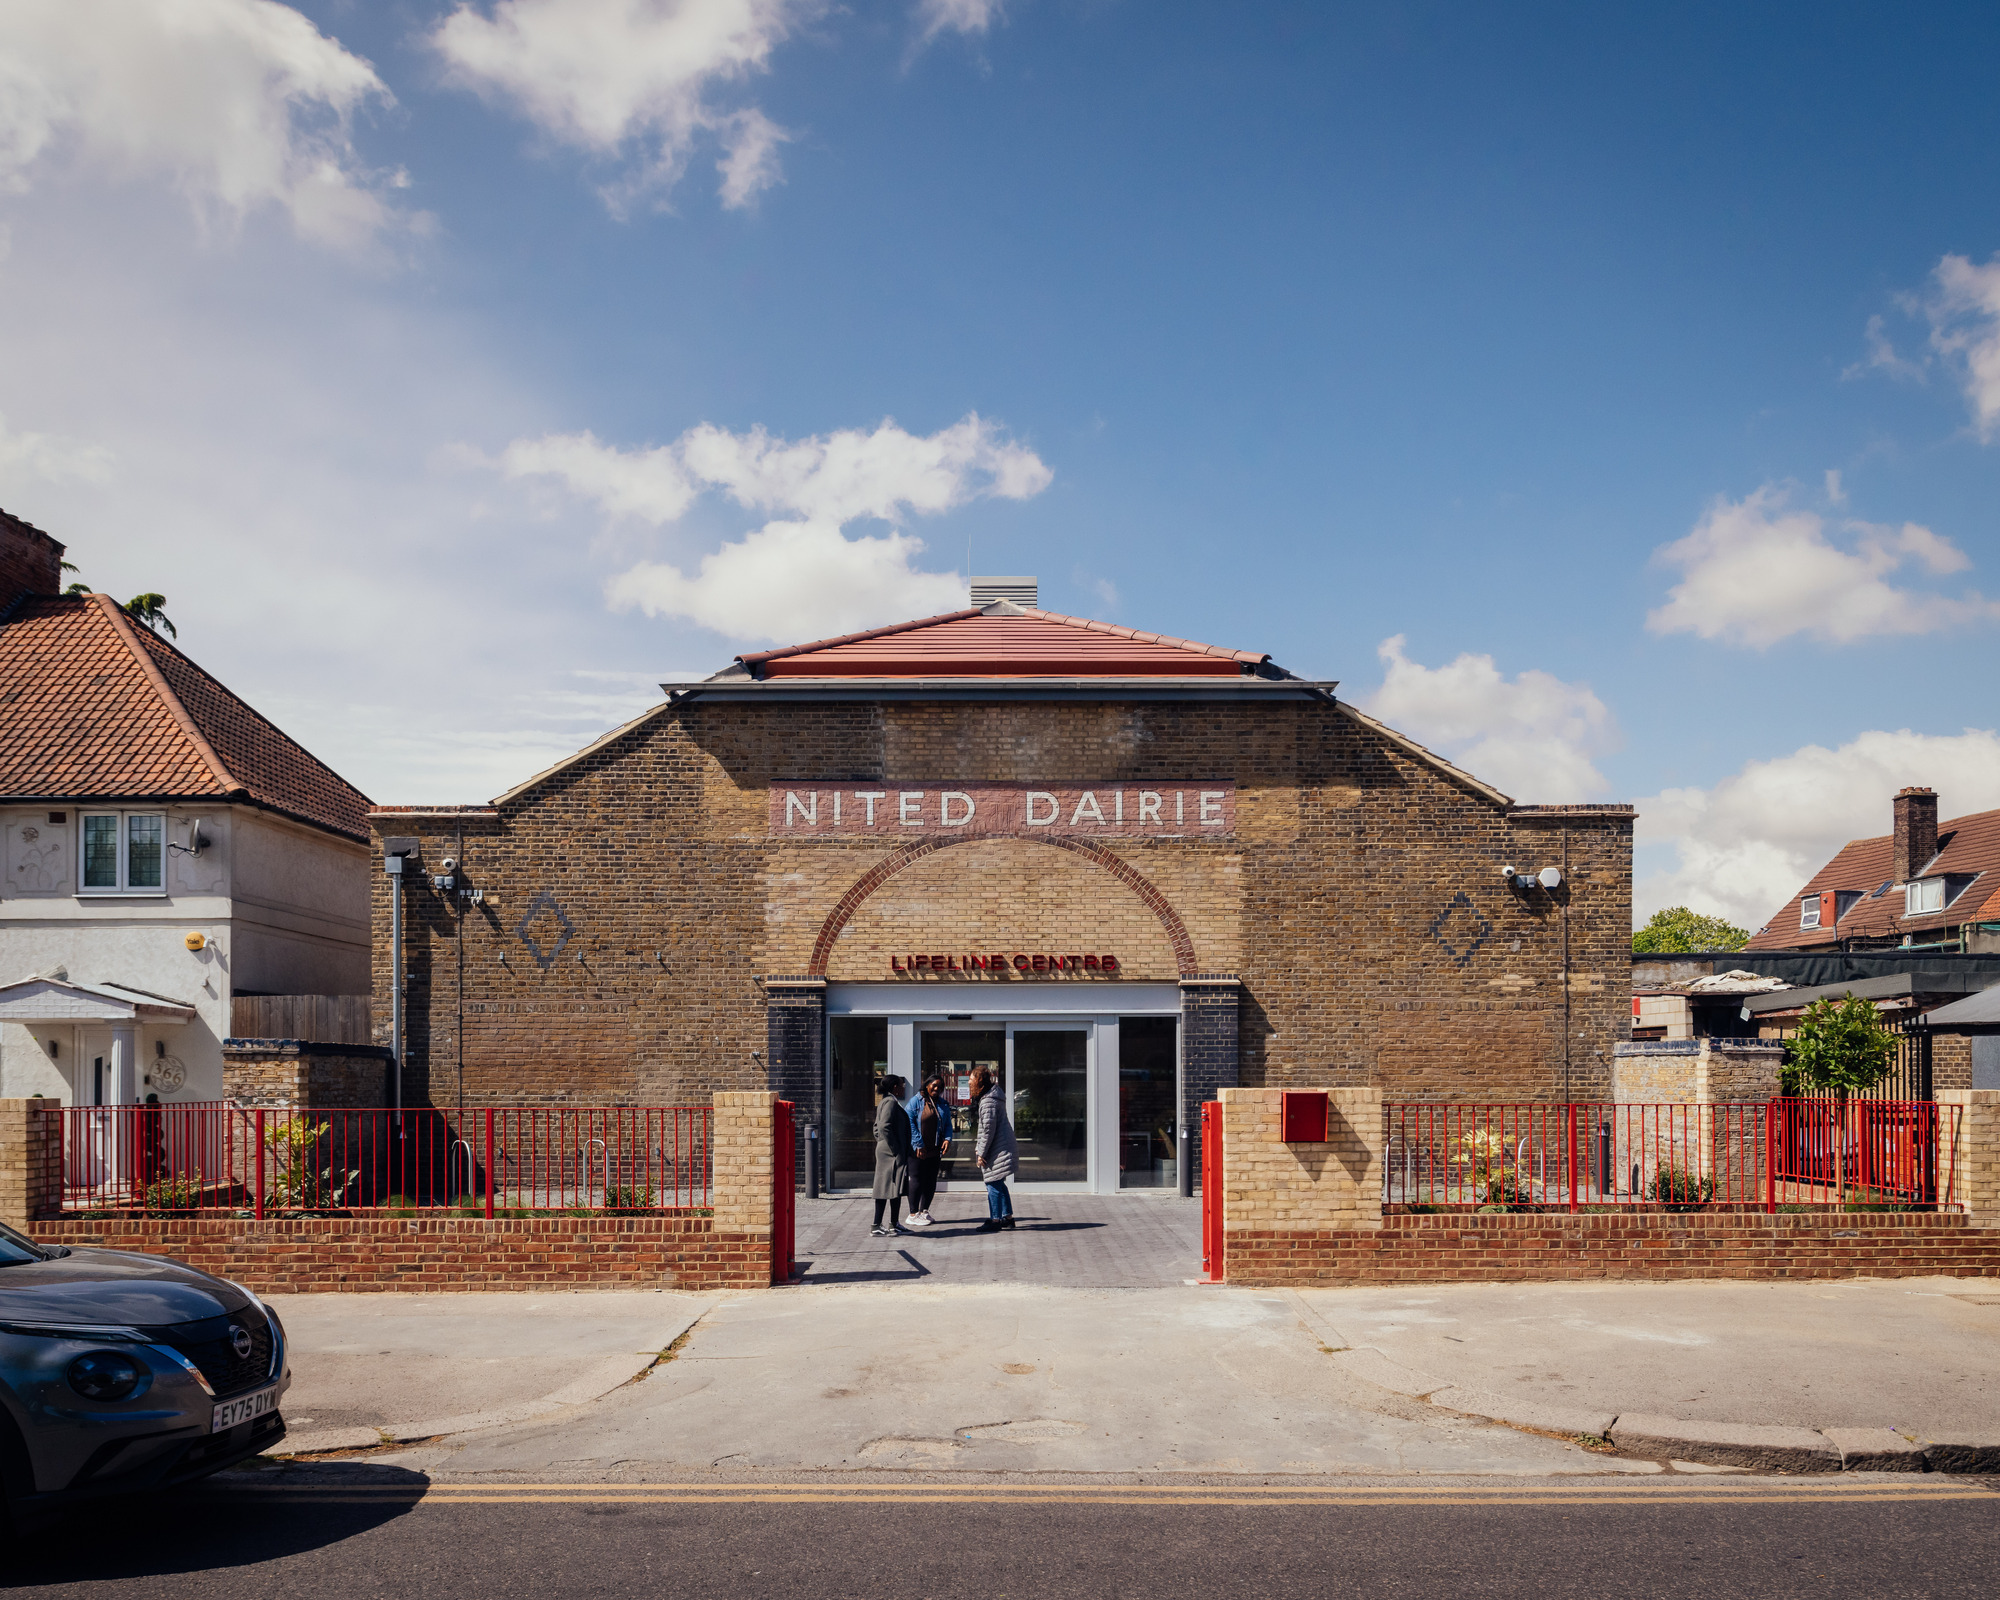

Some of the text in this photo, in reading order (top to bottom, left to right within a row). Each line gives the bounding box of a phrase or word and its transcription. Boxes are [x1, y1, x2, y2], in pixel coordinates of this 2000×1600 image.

[785, 791, 1226, 826] NITED DAIRIE
[891, 954, 1116, 971] LIFELINE CENTRE
[153, 1063, 182, 1085] 366
[221, 1397, 254, 1427] EY75
